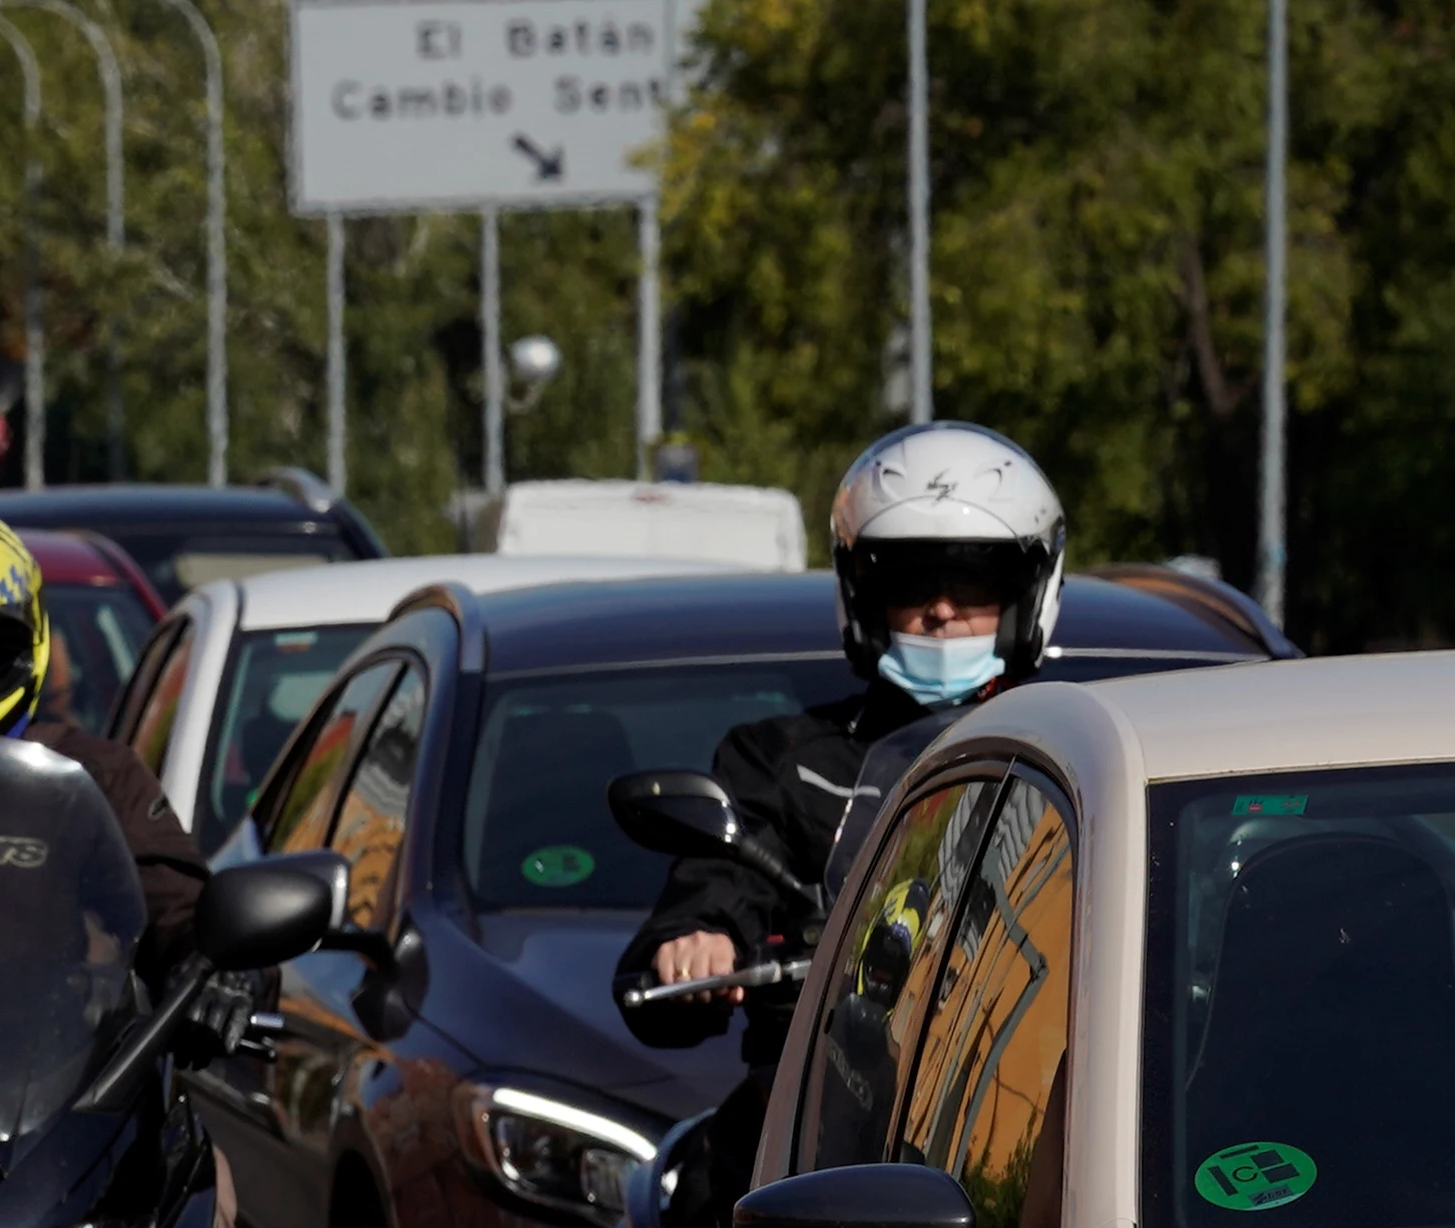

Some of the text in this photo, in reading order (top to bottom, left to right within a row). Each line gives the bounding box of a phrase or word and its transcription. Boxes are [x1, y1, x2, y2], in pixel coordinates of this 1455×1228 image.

[415, 17, 655, 60] El Batán
[331, 74, 514, 121] Cambio
[1233, 1166, 1258, 1182] C
